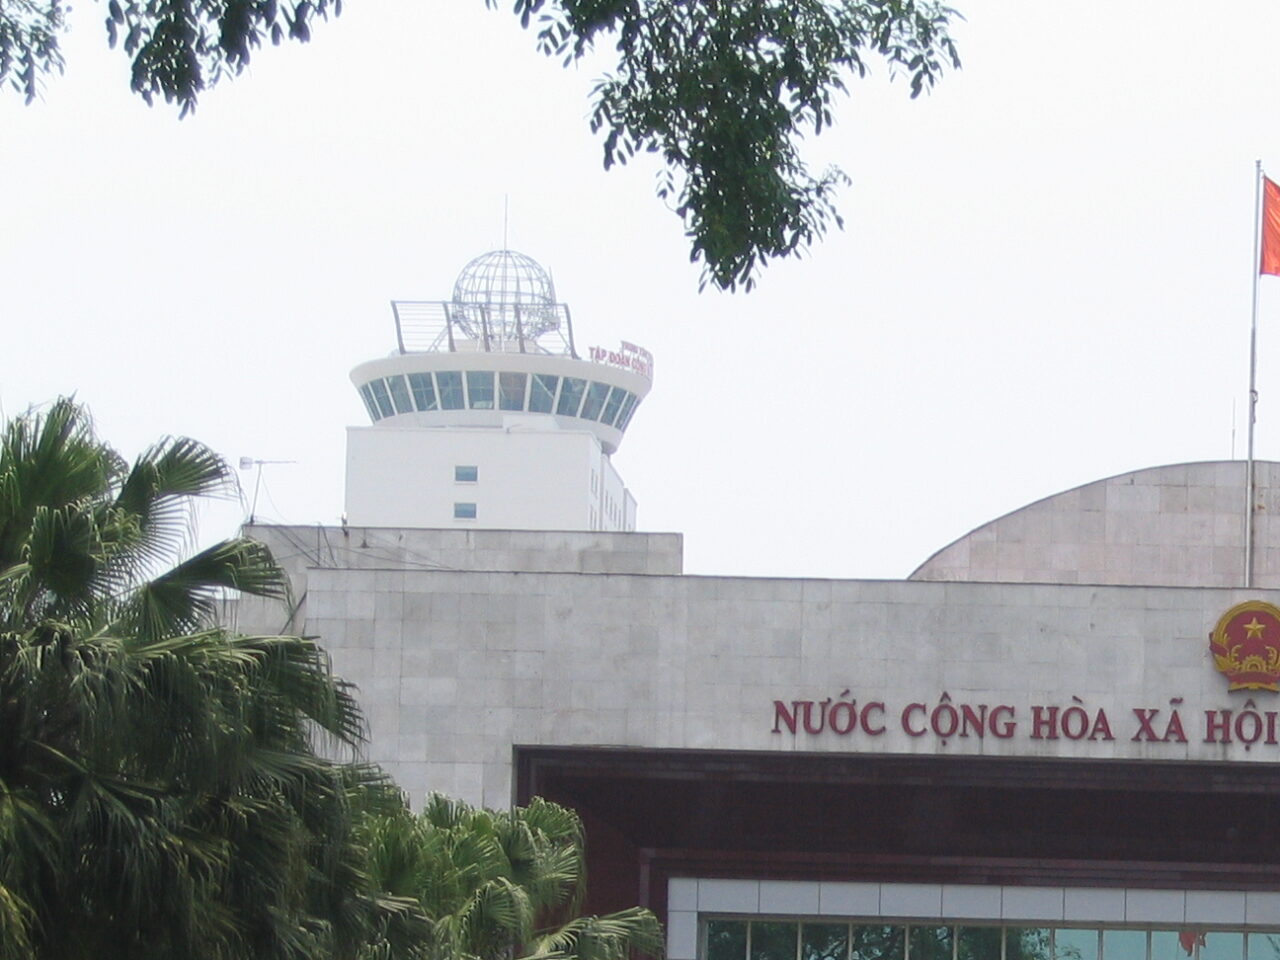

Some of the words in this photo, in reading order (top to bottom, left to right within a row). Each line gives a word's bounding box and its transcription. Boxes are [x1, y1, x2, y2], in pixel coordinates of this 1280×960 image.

[771, 689, 887, 737] NƯỚC
[901, 692, 1018, 746] CỘNG
[1029, 696, 1115, 743] HÒA
[1131, 697, 1189, 744] XÃ
[1204, 698, 1279, 752] HỘI
